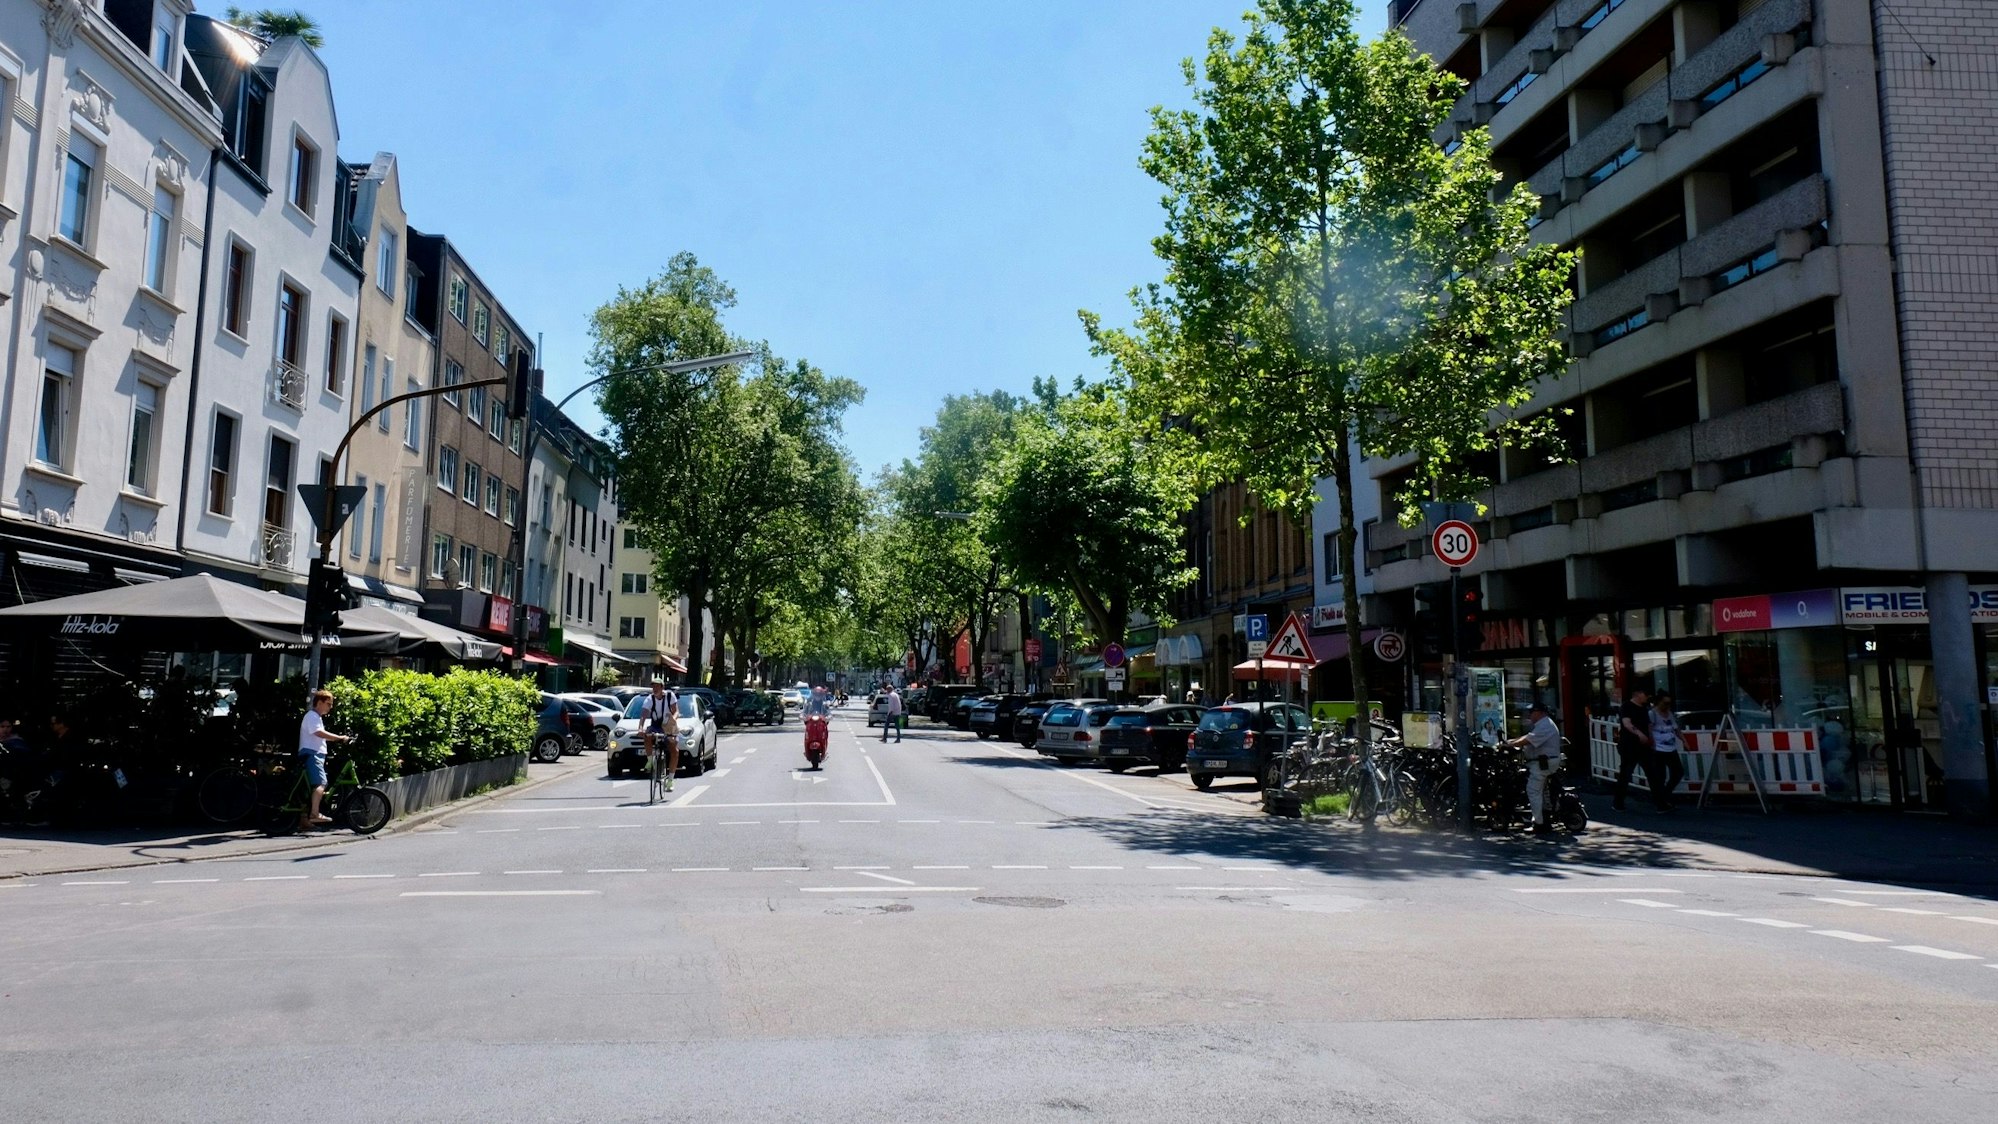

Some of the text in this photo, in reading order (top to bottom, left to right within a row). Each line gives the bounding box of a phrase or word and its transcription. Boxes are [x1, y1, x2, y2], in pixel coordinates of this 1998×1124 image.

[1442, 534, 1468, 553] 30
[1844, 591, 1998, 611] FRIES
[490, 600, 509, 627] REWE
[1732, 609, 1757, 619] vodafone
[61, 615, 119, 633] fritz-kola
[1251, 618, 1262, 637] P
